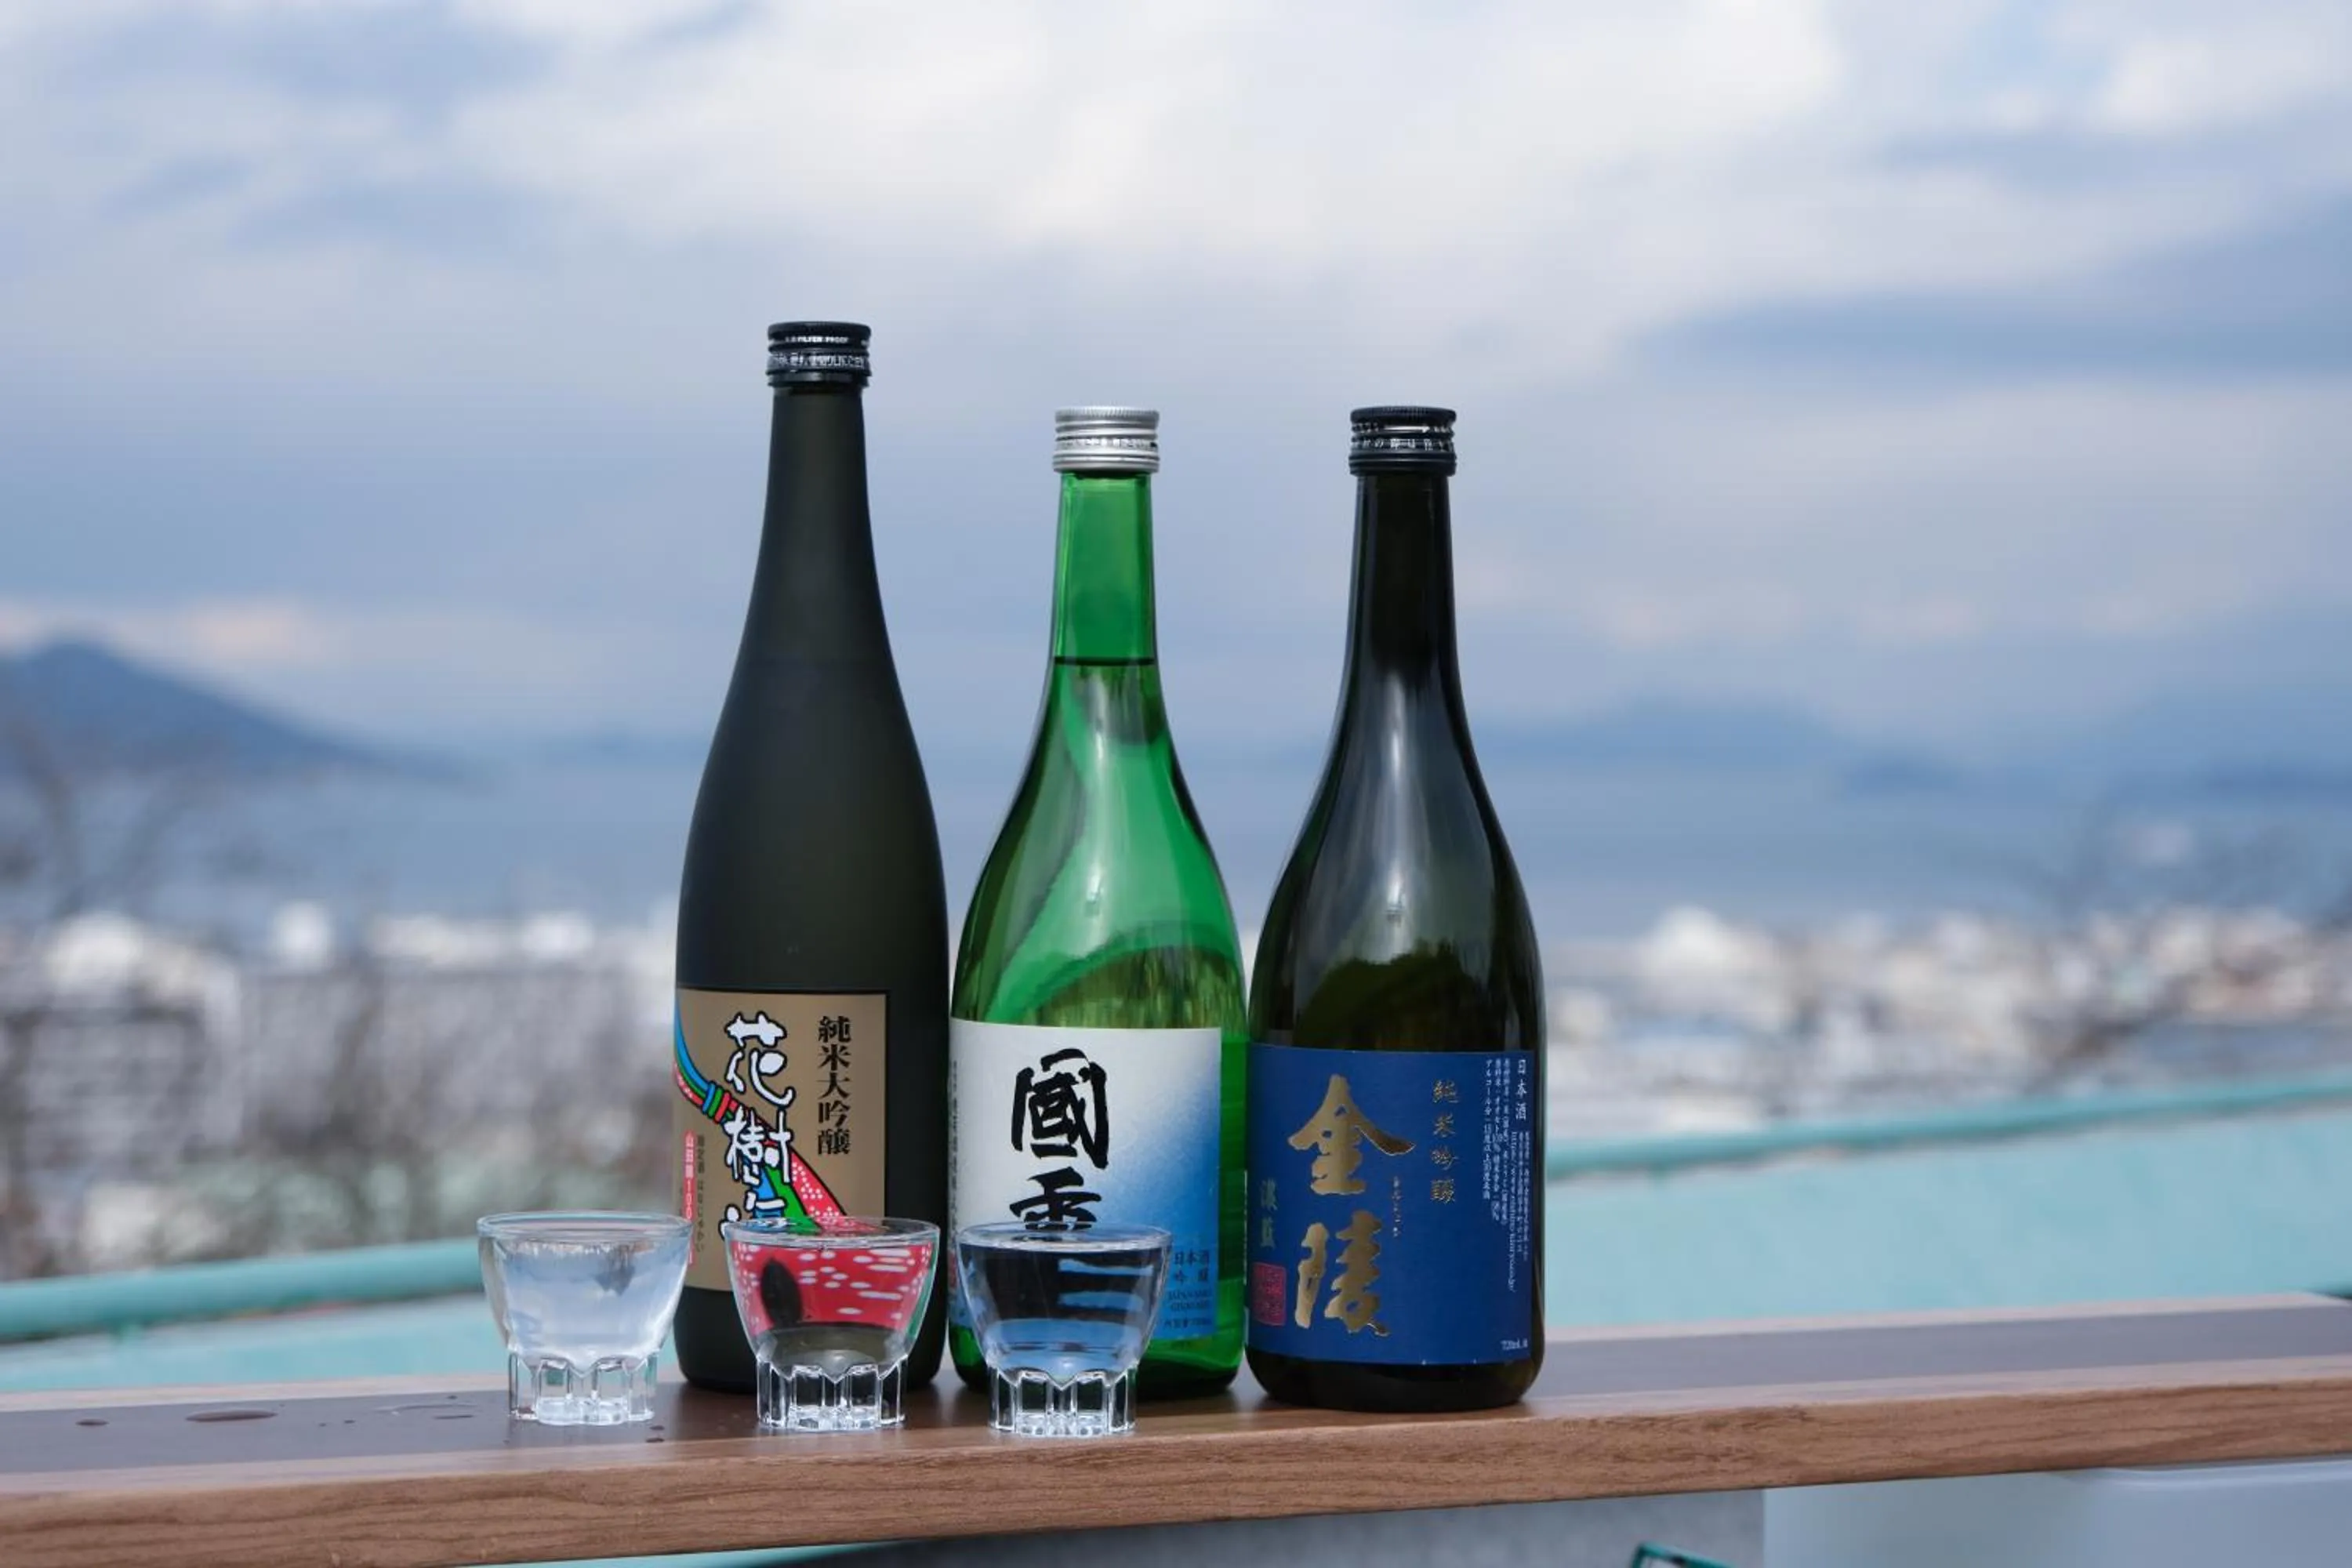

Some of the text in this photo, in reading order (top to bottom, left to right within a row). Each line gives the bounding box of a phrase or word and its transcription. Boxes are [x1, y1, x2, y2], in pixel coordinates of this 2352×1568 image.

[718, 1011, 796, 1241] 花樹
[818, 1016, 852, 1156] 純米大吟醸
[1515, 1059, 1527, 1120] 日本酒
[1287, 1073, 1417, 1337] 金陵
